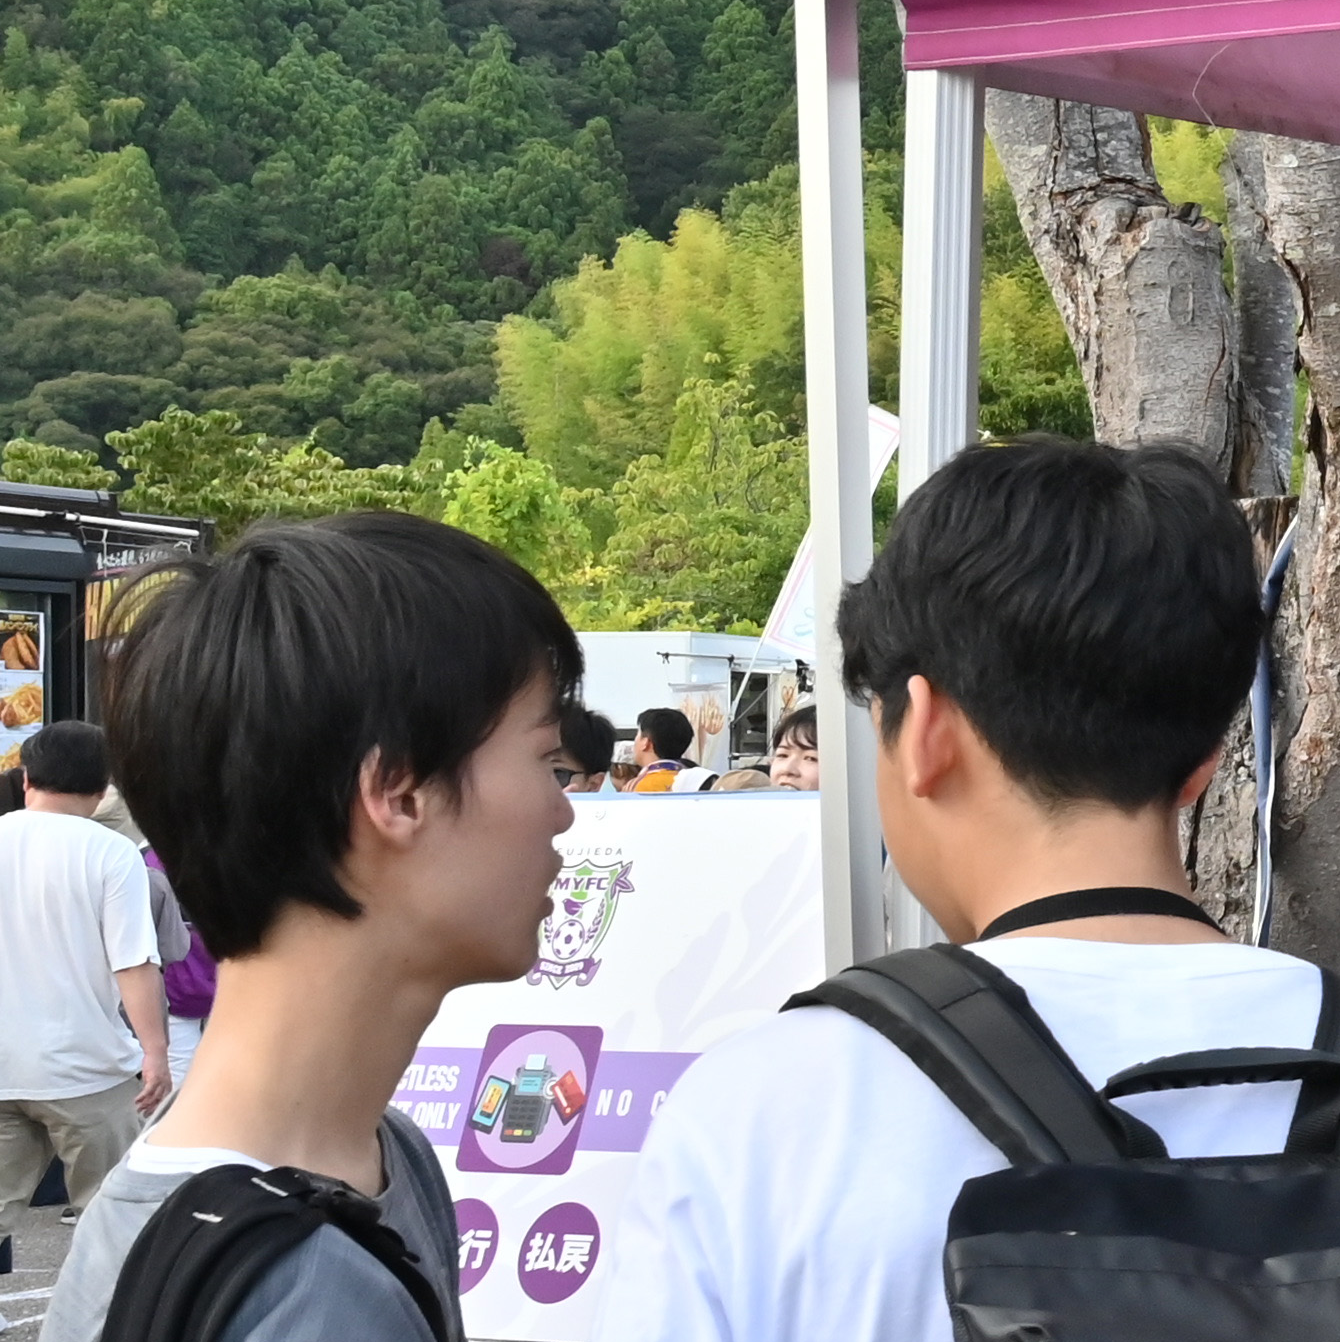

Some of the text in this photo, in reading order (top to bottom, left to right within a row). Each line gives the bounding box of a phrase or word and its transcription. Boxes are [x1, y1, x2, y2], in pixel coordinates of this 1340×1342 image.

[554, 877, 609, 891] MYFC
[422, 1101, 461, 1130] ONLY
[458, 1229, 493, 1270] 行
[525, 1232, 595, 1274] 払戻
